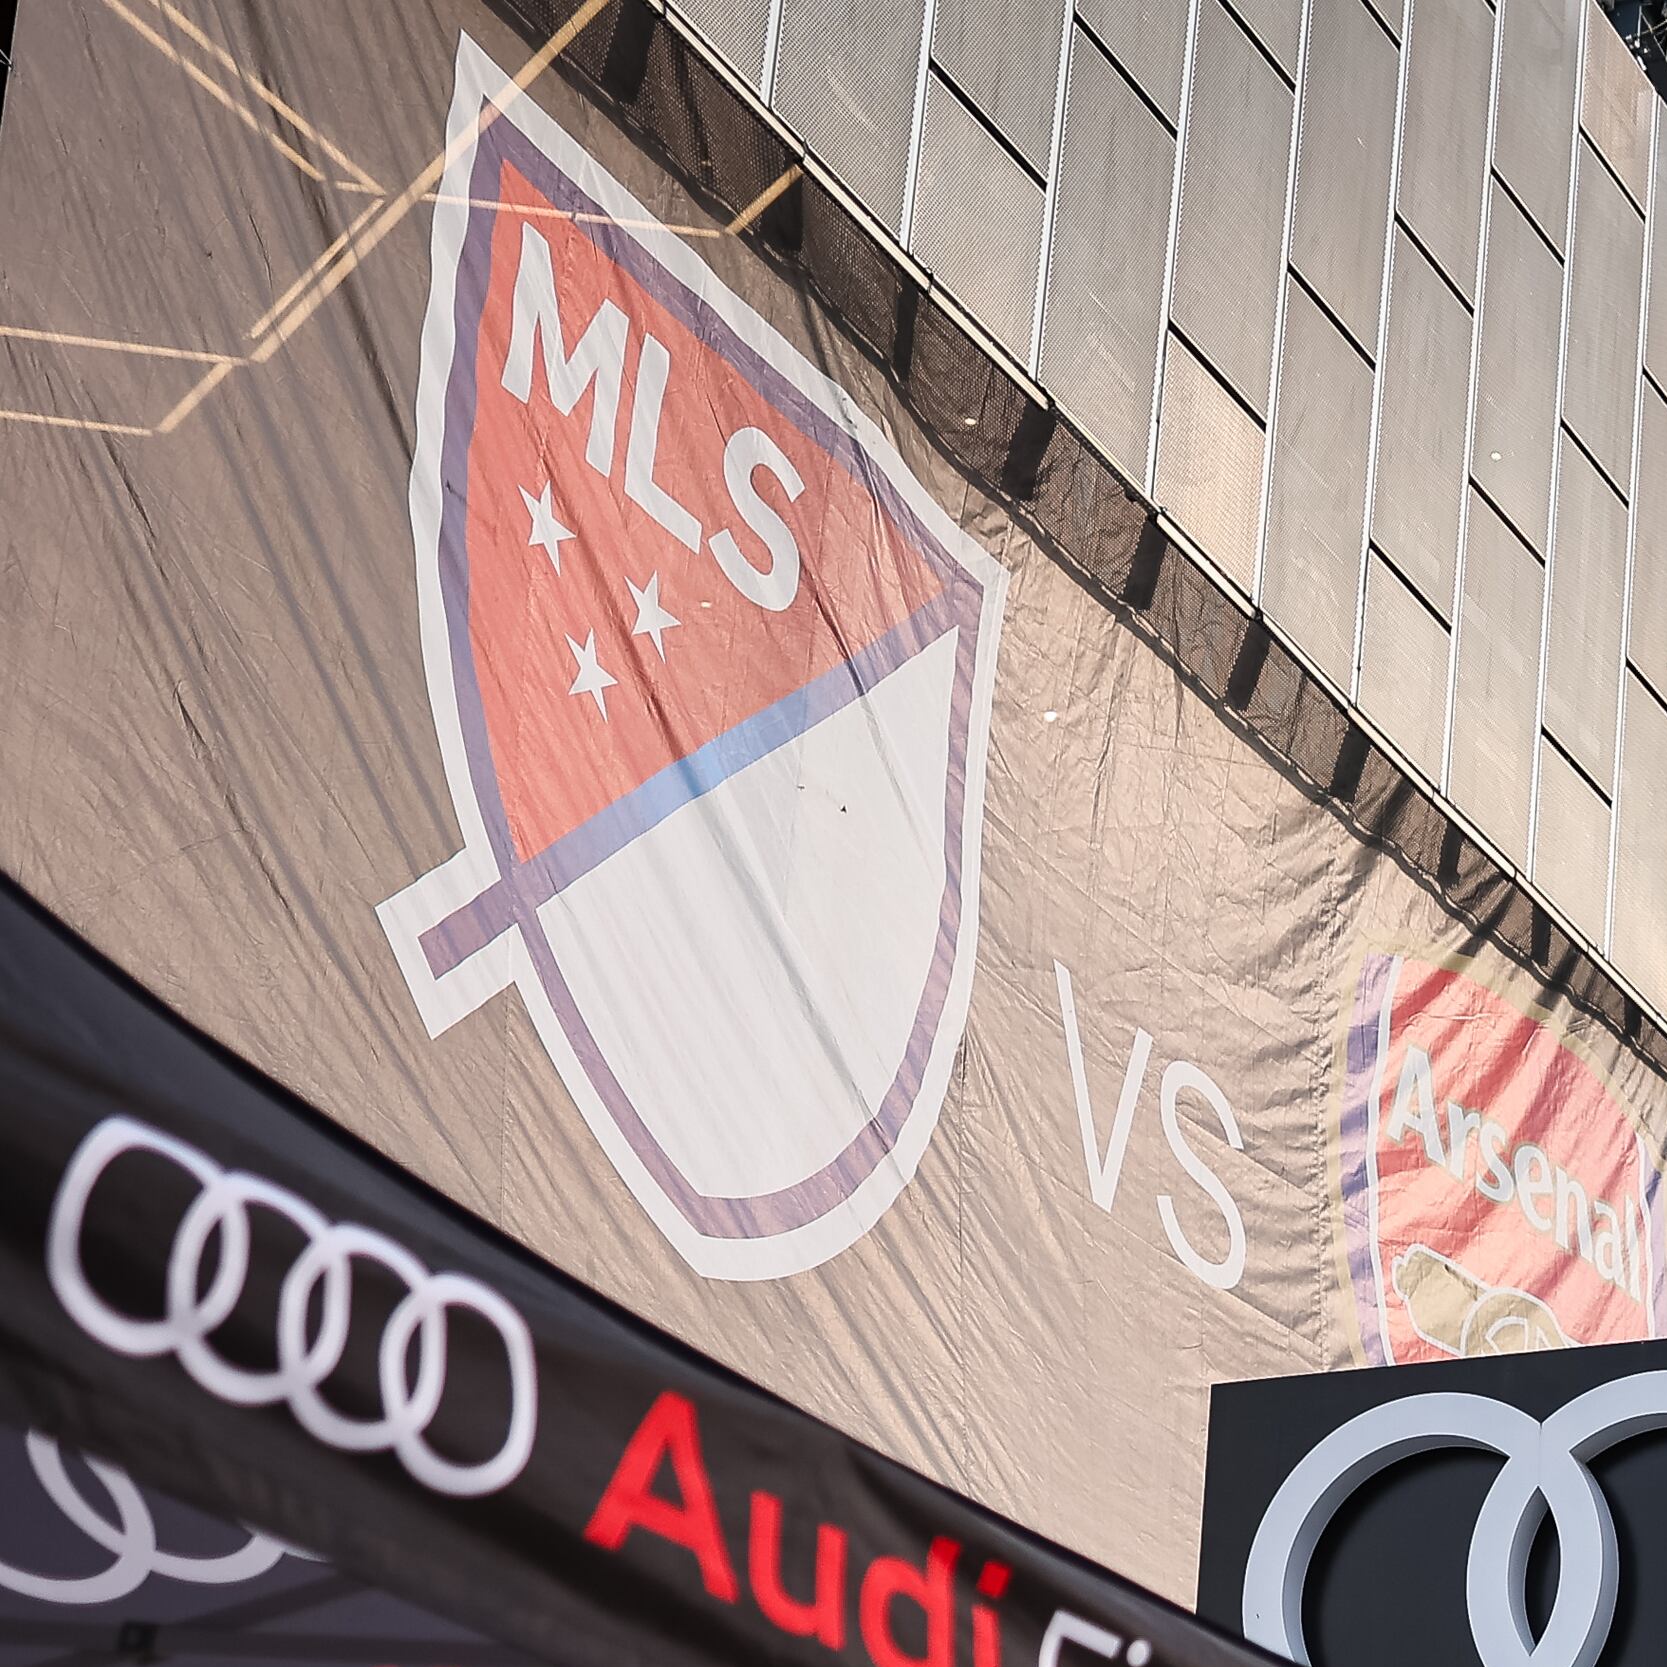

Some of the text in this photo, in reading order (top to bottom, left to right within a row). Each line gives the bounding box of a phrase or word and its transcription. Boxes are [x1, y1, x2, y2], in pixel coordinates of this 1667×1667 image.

[500, 222, 805, 612] MLS
[1054, 958, 1245, 1290] VS
[1386, 1043, 1644, 1301] Arsenal
